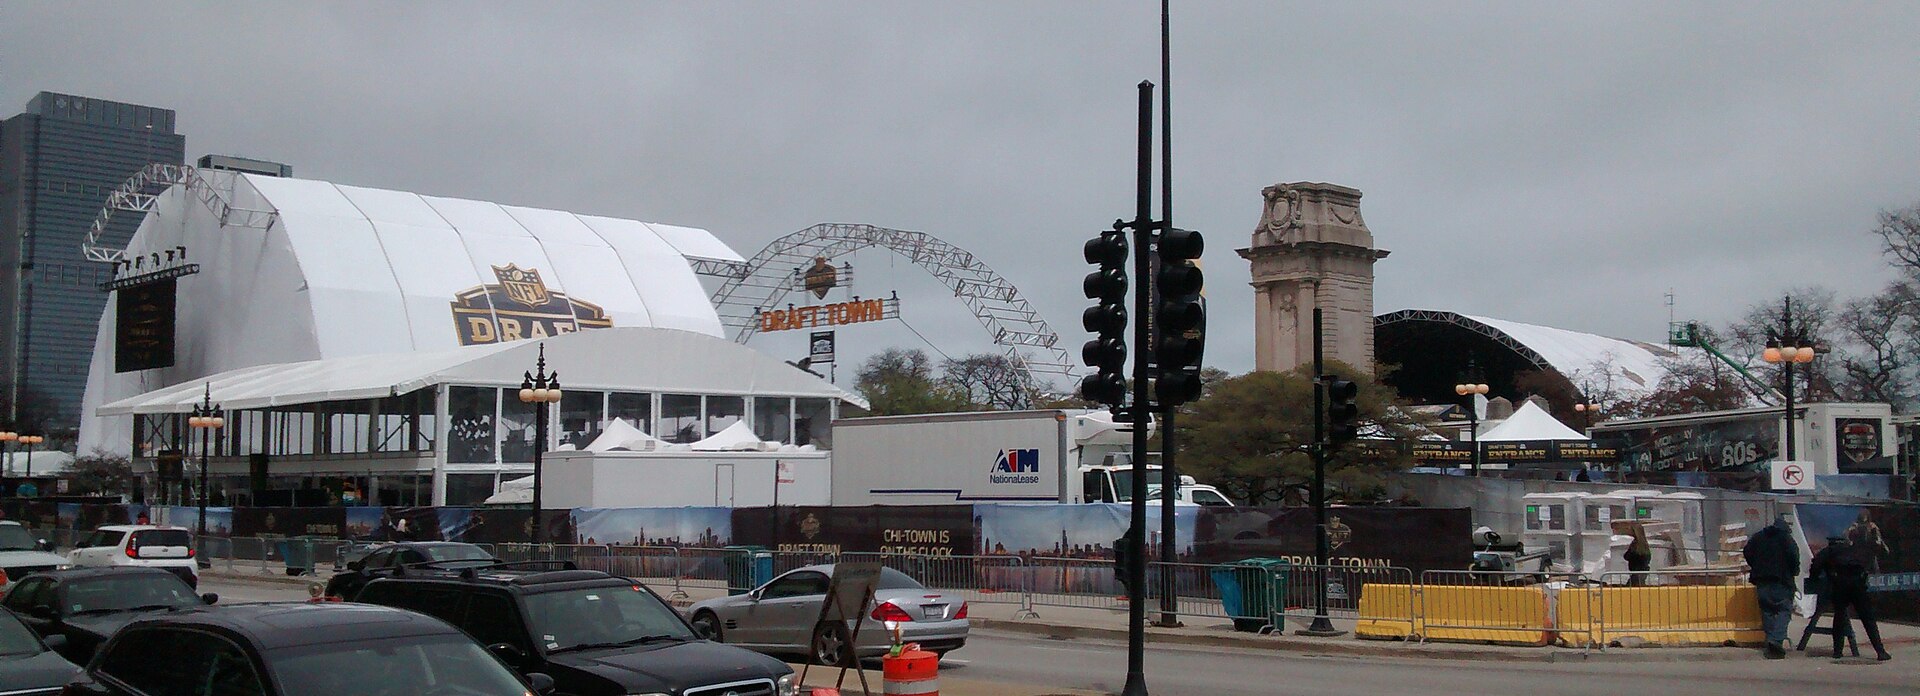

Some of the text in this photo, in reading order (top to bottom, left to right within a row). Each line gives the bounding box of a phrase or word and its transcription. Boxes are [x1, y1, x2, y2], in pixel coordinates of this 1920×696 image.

[506, 282, 545, 301] NFL
[762, 298, 884, 332] DRAFT TOWN
[467, 316, 580, 343] DRAF
[1413, 450, 1472, 460] ENTRANCE
[1488, 449, 1546, 460] ENTRANCE
[1560, 449, 1616, 459] ENTRANCE
[883, 529, 950, 544] CHI-TOWN IS
[880, 545, 953, 561] ON THE CLOCK
[1339, 557, 1391, 574] TOWN
